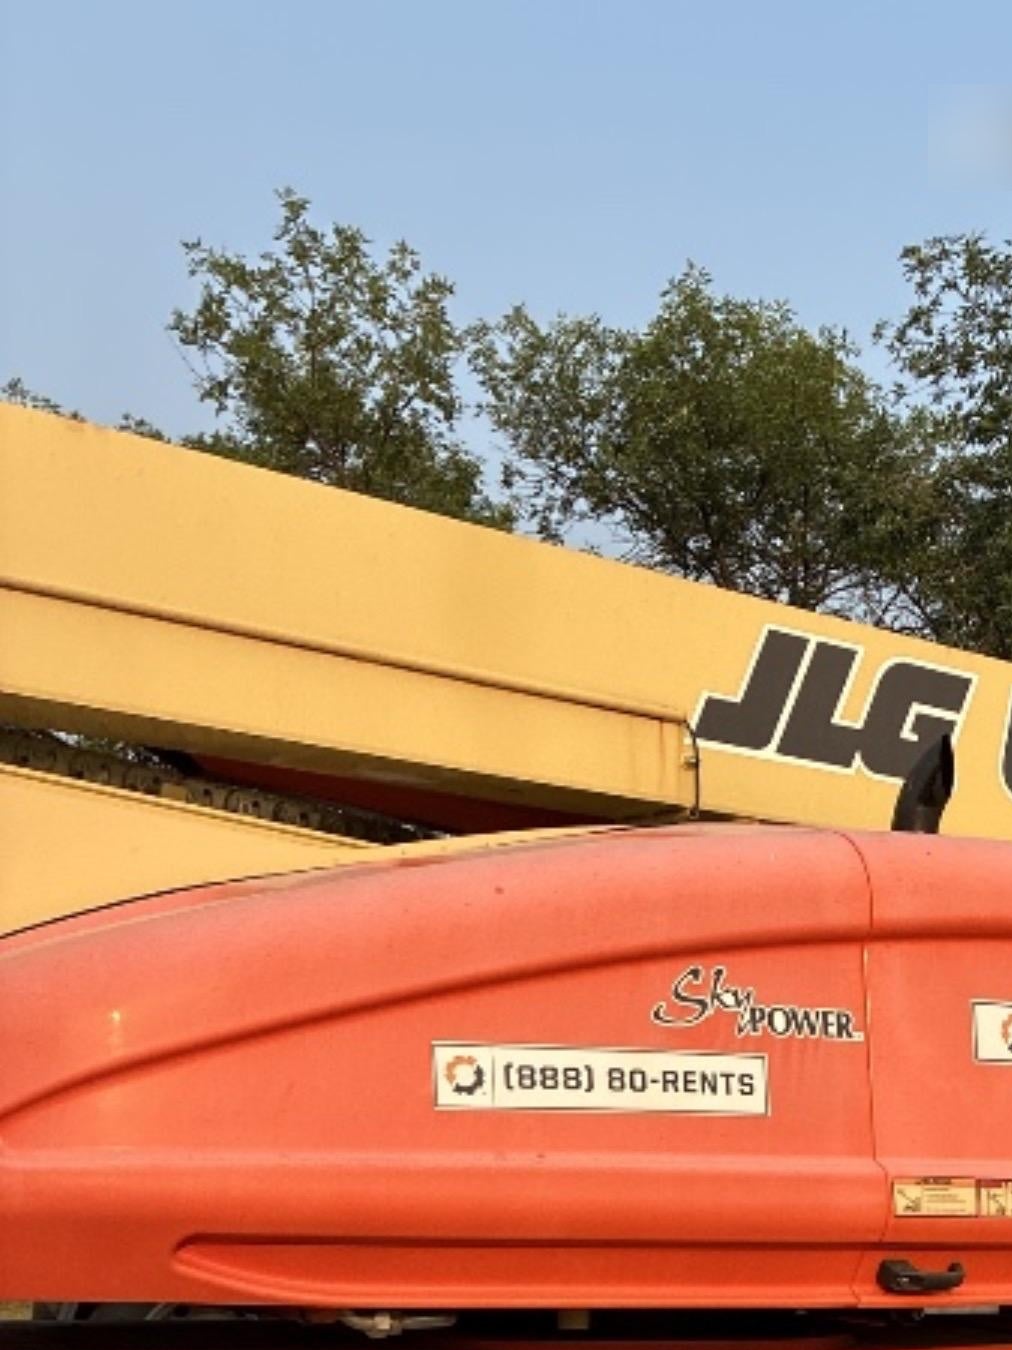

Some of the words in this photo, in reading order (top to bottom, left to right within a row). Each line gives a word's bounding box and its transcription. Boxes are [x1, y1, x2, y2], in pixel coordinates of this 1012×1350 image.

[694, 627, 975, 781] JLG
[652, 967, 753, 1035] Sky
[749, 1007, 856, 1039] POWER
[502, 1062, 596, 1093] (888)
[607, 1066, 756, 1097] 80-RENTS
